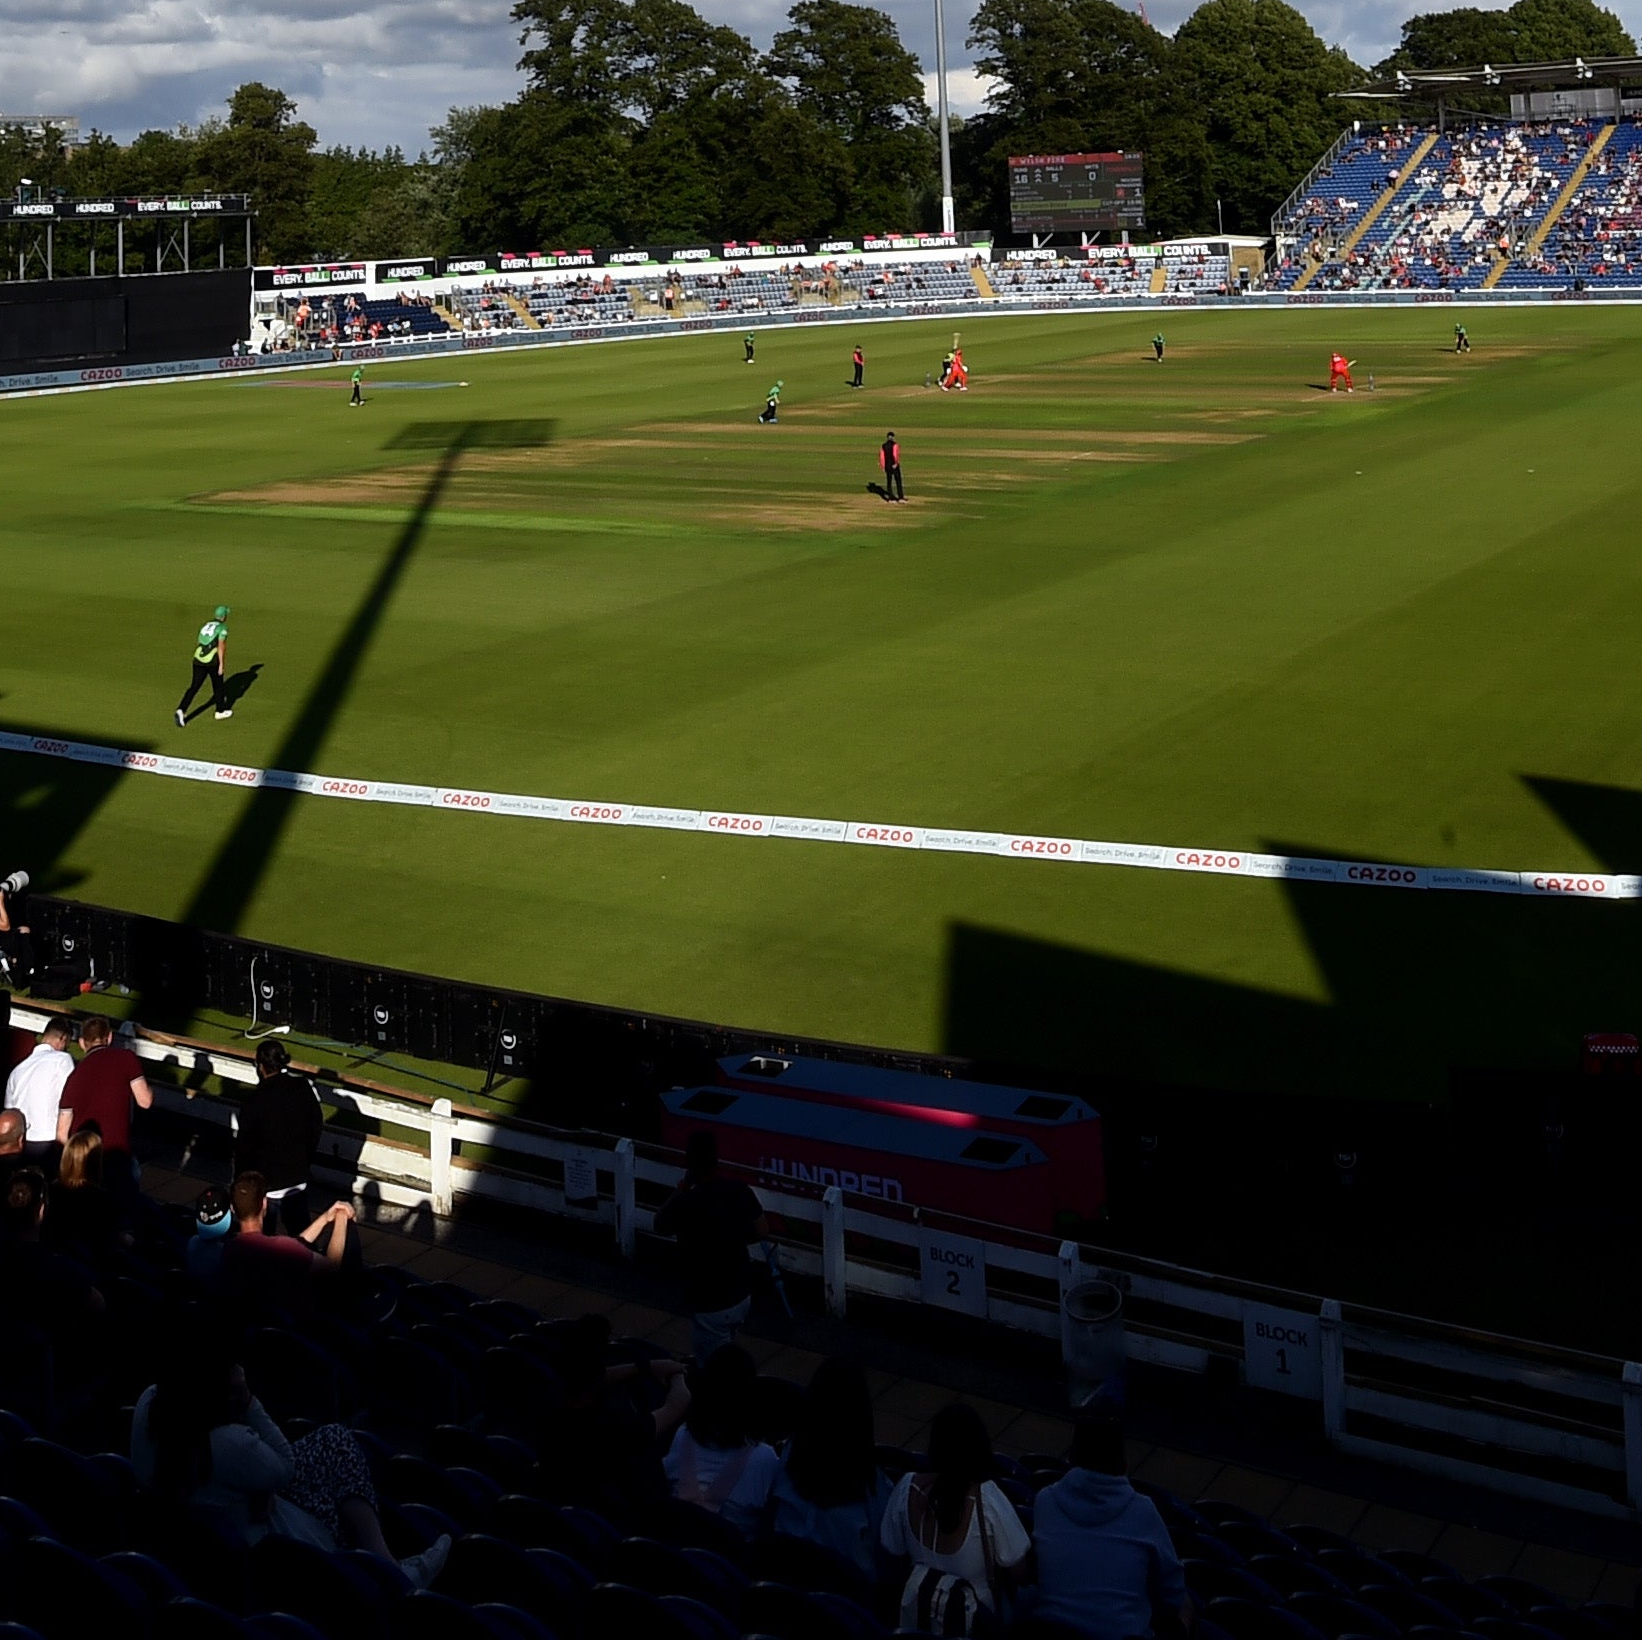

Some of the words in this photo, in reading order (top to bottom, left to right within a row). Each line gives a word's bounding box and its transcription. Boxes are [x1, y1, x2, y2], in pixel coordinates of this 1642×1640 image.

[13, 204, 55, 215] HUNDRED
[76, 202, 115, 213] HUNDRED
[447, 261, 486, 273] HUNDRED
[609, 252, 649, 264] HUNDRED
[672, 249, 711, 261] HUNDRED
[819, 241, 854, 252] HUNDRED
[1006, 250, 1057, 260] HUNDRED
[273, 273, 305, 286] EVERY.
[387, 266, 424, 279] HUNDRED
[351, 347, 384, 359] CAZOO
[219, 356, 255, 369] CAZOO
[81, 368, 122, 381] CAZOO
[34, 740, 69, 754] CAZOO
[122, 754, 158, 768] CAZOO
[216, 768, 256, 783] CAZOO
[322, 781, 368, 795] CAZOO
[443, 793, 491, 808] CAZOO
[570, 806, 622, 820] CAZOO
[708, 816, 763, 831] CAZOO
[857, 827, 914, 842] CAZOO
[1011, 840, 1072, 855] CAZOO
[1175, 852, 1240, 868] CAZOO
[1347, 866, 1417, 883] CAZOO
[1534, 876, 1605, 892] CAZOO
[930, 1246, 975, 1270] BLOCK
[946, 1270, 961, 1297] 2
[1256, 1321, 1309, 1348] BLOCK
[1276, 1348, 1292, 1375] 1
